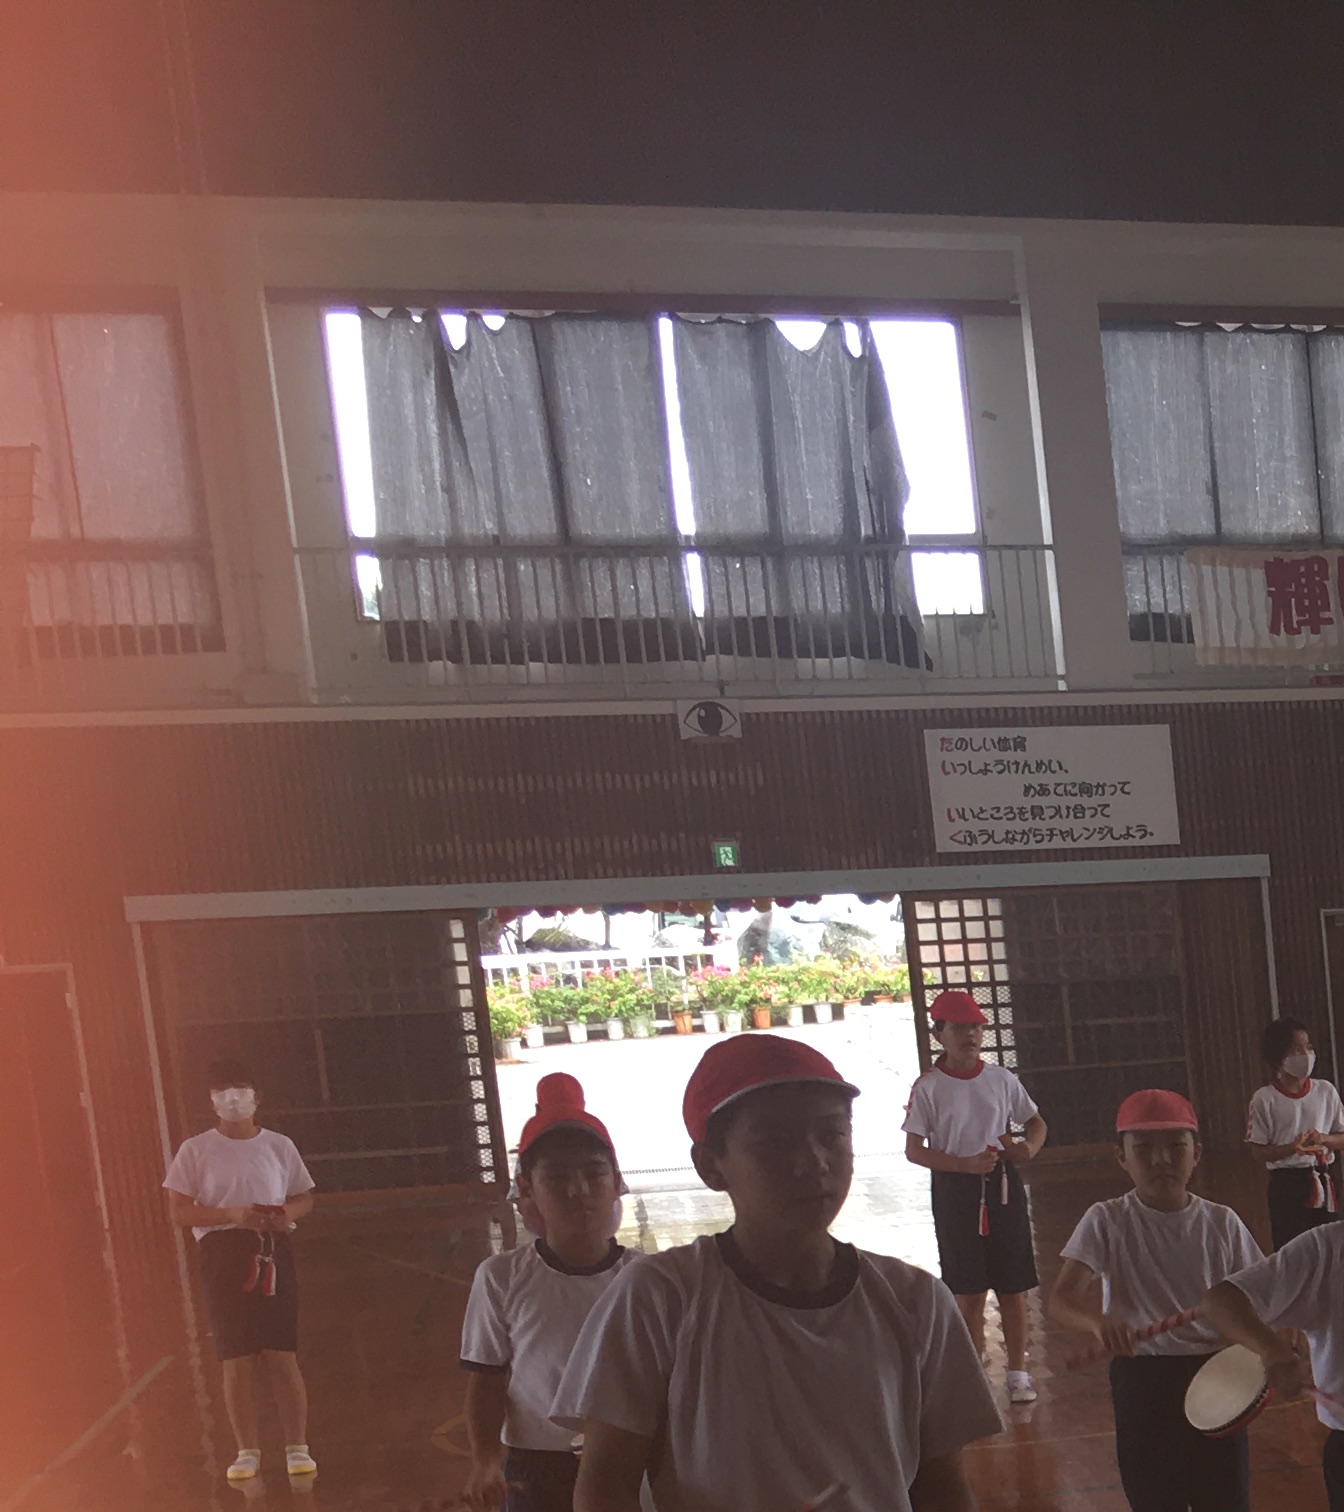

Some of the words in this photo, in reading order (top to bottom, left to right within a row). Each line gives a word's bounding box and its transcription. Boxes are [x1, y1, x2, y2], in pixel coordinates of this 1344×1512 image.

[939, 736, 1027, 752] たのしい体育
[1023, 781, 1131, 798] めあてに向かって
[947, 803, 1111, 822] いいところを見つけ合って
